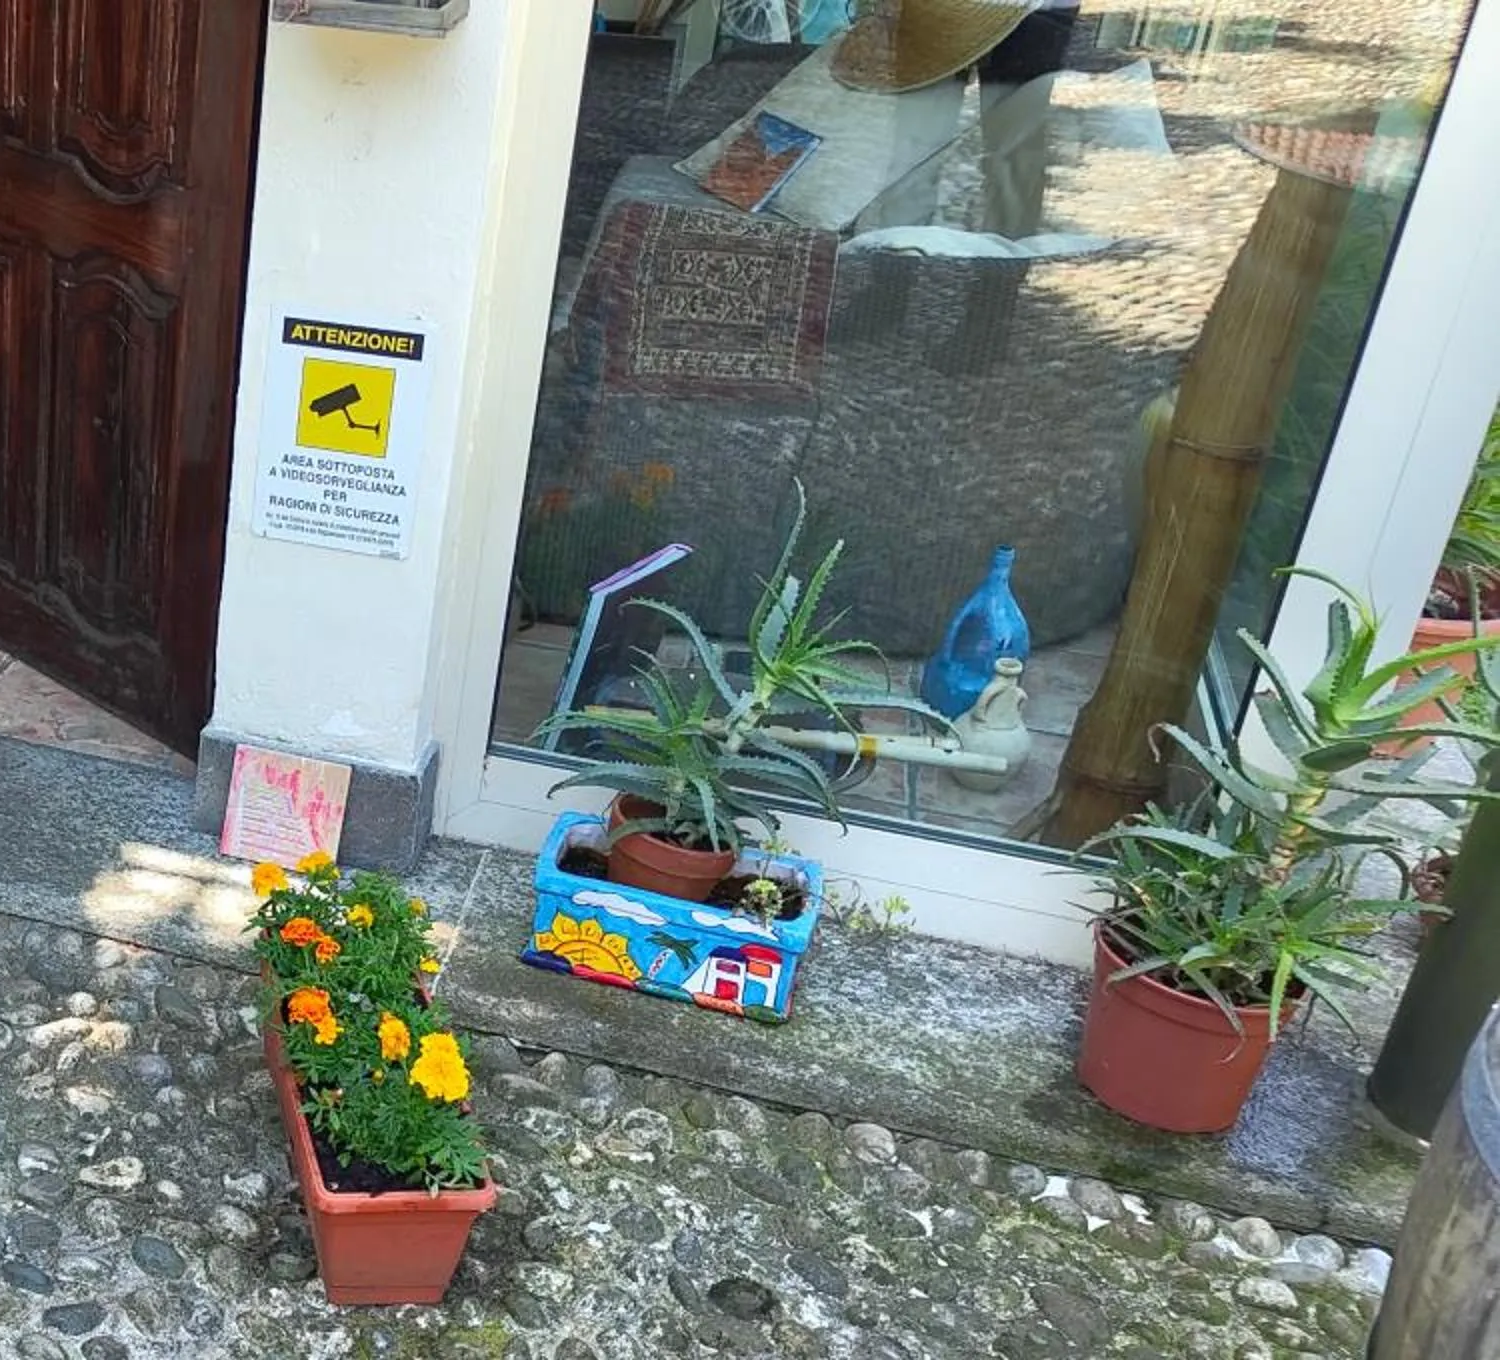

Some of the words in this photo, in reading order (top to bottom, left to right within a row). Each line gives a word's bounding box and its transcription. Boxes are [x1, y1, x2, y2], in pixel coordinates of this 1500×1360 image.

[291, 324, 415, 355] ATTENZIONE!
[269, 466, 277, 477] A
[281, 468, 407, 497] VIDEOSORVEGLIANZA
[281, 453, 313, 469] AREA
[317, 458, 395, 481] SOTTOPOSTA
[269, 495, 317, 514] RAGIONI
[319, 503, 331, 515] DI
[334, 505, 400, 526] SICUREZZA
[323, 489, 348, 503] PER
